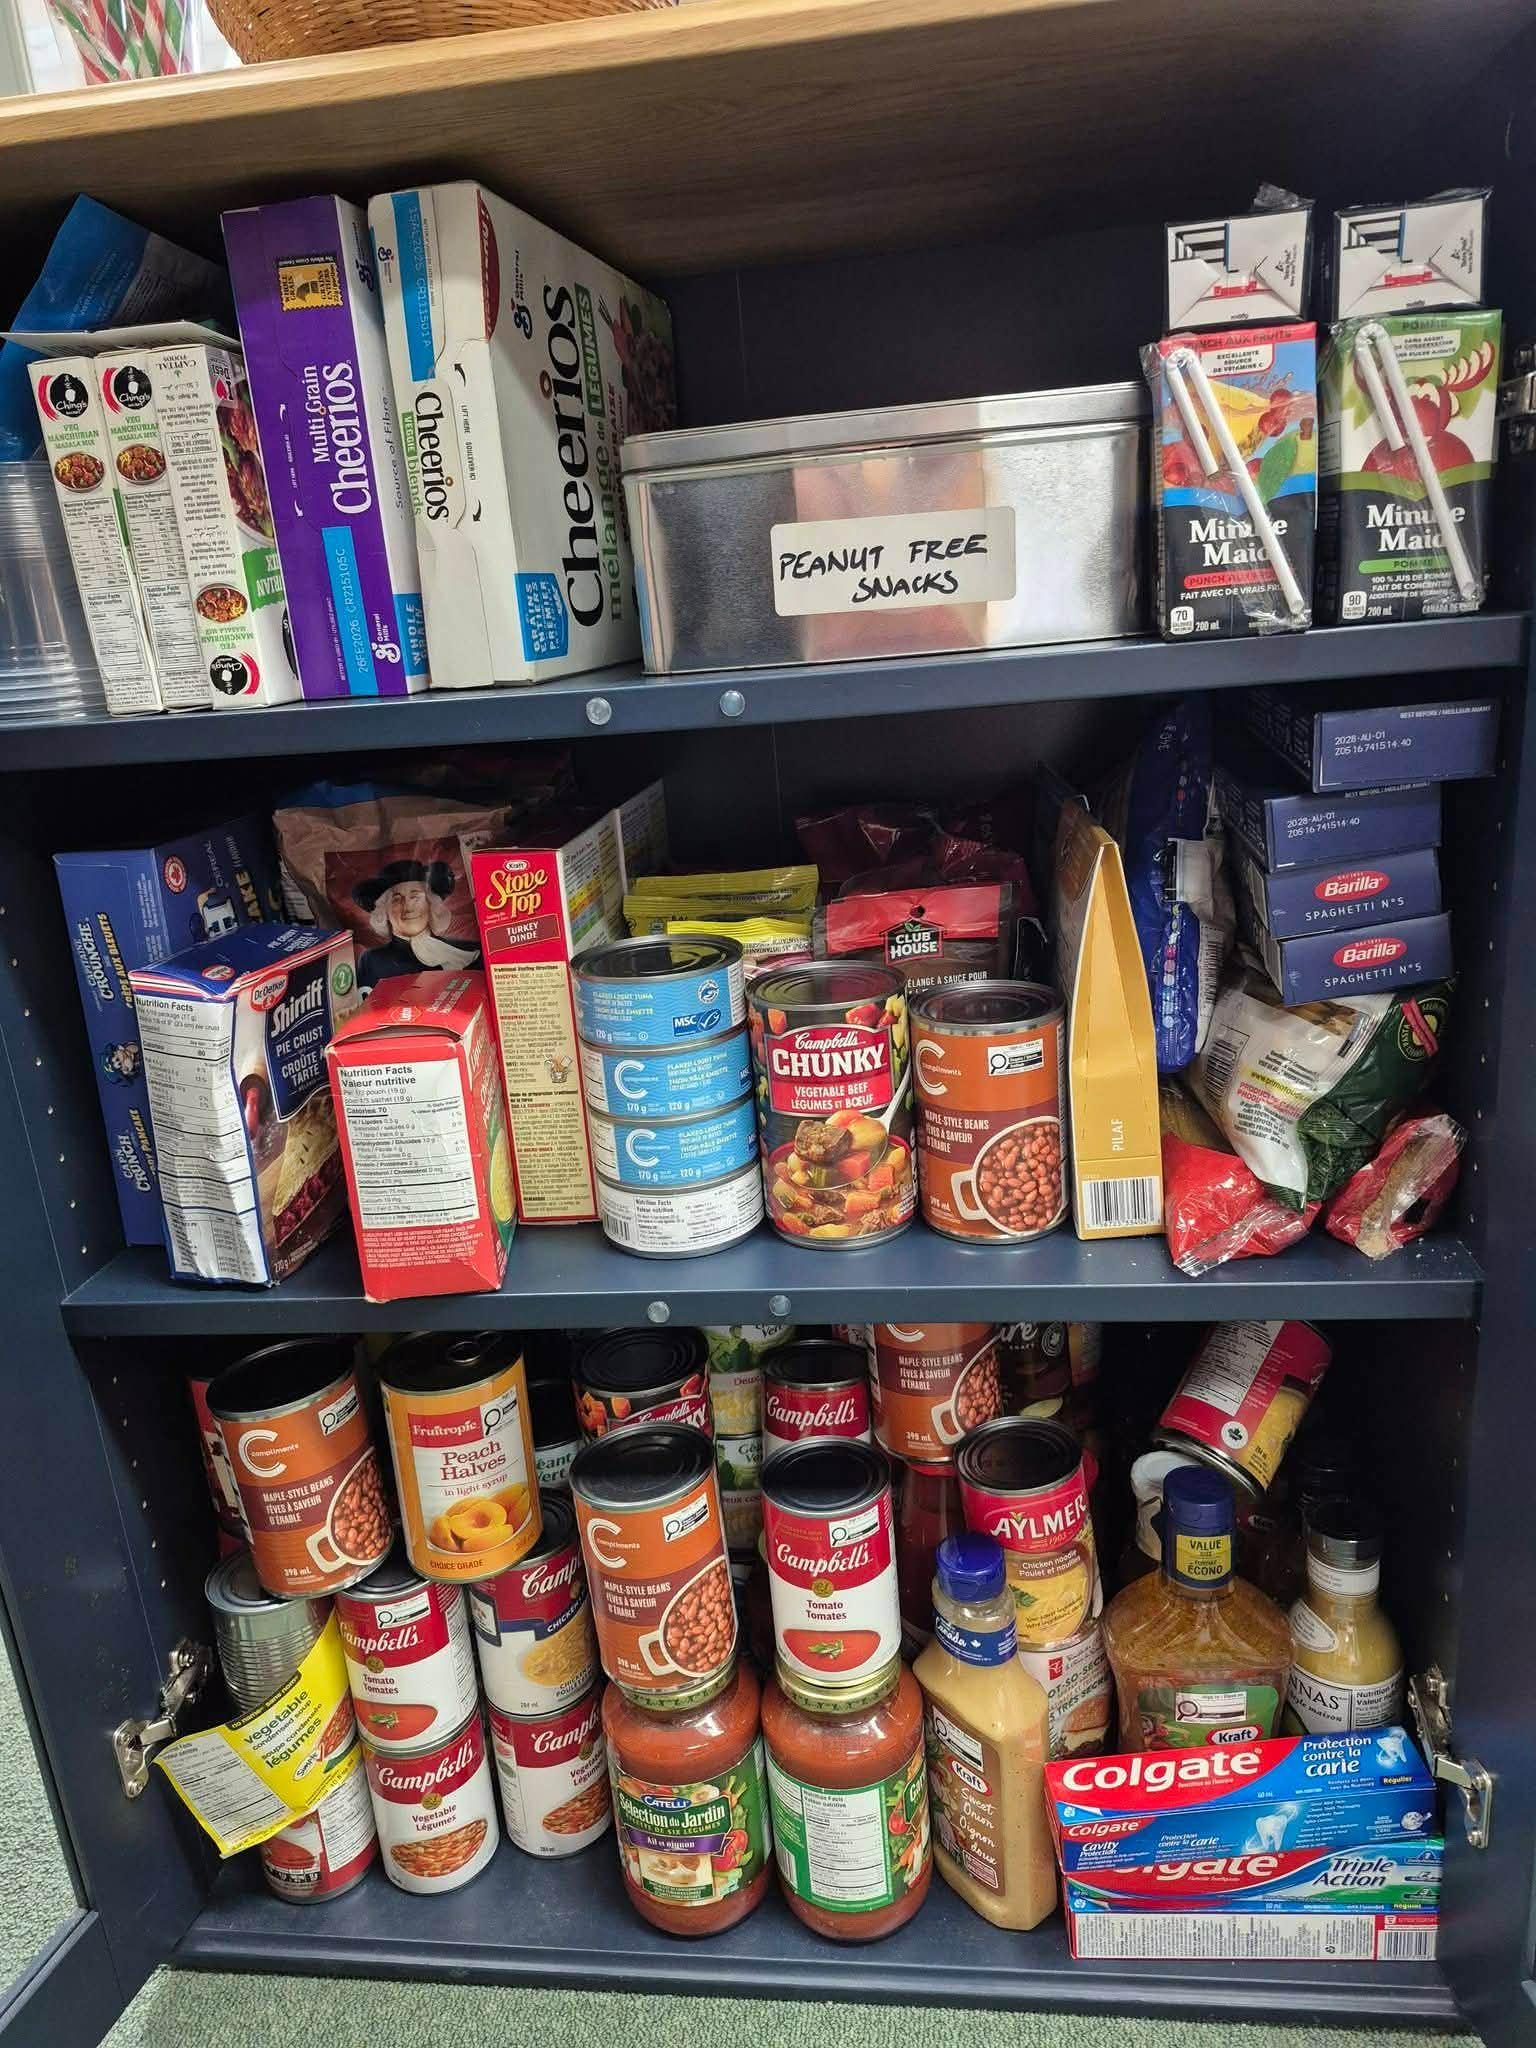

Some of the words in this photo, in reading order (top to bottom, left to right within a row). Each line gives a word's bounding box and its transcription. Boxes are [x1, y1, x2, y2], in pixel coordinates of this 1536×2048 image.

[158, 360, 197, 372] CAPITAL
[301, 365, 326, 414] Grain
[55, 400, 88, 413] Ching's
[119, 393, 151, 404] Ching's
[382, 396, 394, 434] Fibre
[309, 418, 331, 464] Multi
[322, 361, 372, 515] Cheerios
[405, 415, 415, 454] VEGGIE
[415, 391, 450, 521] Cheerios
[543, 284, 604, 628] Cheerios
[390, 460, 404, 509] Source
[407, 455, 424, 515] blends
[779, 545, 885, 581] PEANUT
[908, 533, 989, 564] FREE
[1189, 574, 1225, 586] PUNCH
[1395, 574, 1411, 582] JUS
[851, 570, 960, 604] SNACKS
[1180, 591, 1199, 601] FAIT
[1200, 589, 1224, 599] AVEC
[1225, 587, 1239, 596] DE
[1240, 585, 1265, 595] VRAIS
[1372, 583, 1390, 592] FAIT
[1348, 594, 1362, 606] 90
[1175, 610, 1188, 621] 70
[1367, 606, 1382, 617] 200
[405, 602, 423, 666] WHOLE
[1195, 621, 1210, 631] 200
[350, 619, 369, 673] 26FE2026
[1335, 730, 1386, 746] 2028-AU-01
[1287, 811, 1336, 828] 2028-AU-01
[485, 868, 549, 911] Stove
[1324, 876, 1383, 898] Barilla
[507, 893, 542, 919] Top
[1305, 902, 1375, 921] SPAGHETTI
[506, 921, 540, 937] TURKEY
[510, 931, 538, 945] DINDE
[894, 930, 932, 946] CLUB
[890, 941, 938, 961] HOUSE
[1342, 942, 1401, 964] Barilla
[78, 922, 114, 1001] CROUNCHE
[946, 972, 967, 984] SAUCE
[968, 970, 988, 982] POUR
[1324, 967, 1394, 988] SPAGHETTI
[136, 997, 170, 1010] Nutrition
[171, 1001, 194, 1012] Facts
[270, 976, 324, 1039] Shirriff
[673, 1014, 697, 1028] MSC
[276, 1041, 292, 1058] PIE
[292, 1025, 324, 1049] CRUST
[794, 1030, 866, 1053] Campbell's
[281, 1050, 319, 1080] CROÛTE
[771, 1042, 886, 1078] CHUNKY
[290, 1064, 321, 1088] TARTE
[340, 1068, 383, 1078] Nutrition
[385, 1066, 413, 1075] Facts
[342, 1079, 375, 1089] Valeur
[375, 1076, 417, 1087] nutritive
[794, 1085, 845, 1099] VEGETABLE
[847, 1082, 869, 1097] BEEF
[378, 1106, 388, 1114] 70
[627, 1103, 640, 1112] 170
[640, 1105, 647, 1114] g
[684, 1102, 690, 1112] g
[791, 1097, 834, 1111] LÉGUMES
[925, 1110, 963, 1130] MAPLE-STYLE
[964, 1117, 990, 1131] BEANS
[946, 1129, 973, 1144] SAVEUR
[1111, 1117, 1125, 1152] PILAF
[118, 1135, 151, 1192] CRUNCH
[638, 1170, 651, 1180] 170
[652, 1171, 658, 1180] g
[680, 1167, 695, 1178] 120
[695, 1167, 701, 1178] g
[925, 1367, 951, 1379] SAVEUR
[767, 1396, 857, 1429] Campbell's
[411, 1420, 479, 1437] Fruitropic
[905, 1431, 920, 1441] 398
[441, 1440, 502, 1467] Peach
[439, 1453, 507, 1482] Halves
[262, 1484, 311, 1504] MAPLE-STYLE
[310, 1475, 335, 1491] BEANS
[443, 1487, 455, 1497] in
[456, 1483, 480, 1497] light
[481, 1471, 509, 1491] syrup
[293, 1495, 323, 1511] SAVEUR
[990, 1492, 1088, 1540] AYLMER
[1189, 1538, 1223, 1551] VALUE
[429, 1559, 455, 1570] CHOICE
[456, 1559, 484, 1570] GRADE
[775, 1537, 874, 1578] Campbell's
[1022, 1558, 1054, 1571] Chicken
[1054, 1549, 1078, 1566] noodle
[283, 1567, 298, 1577] 398
[1019, 1565, 1046, 1577] Poulet
[1046, 1566, 1055, 1575] et
[603, 1580, 646, 1596] MAPLE-STYLE
[646, 1581, 672, 1596] BEANS
[631, 1597, 657, 1610] SAVEUR
[806, 1599, 844, 1611] Tomato
[806, 1609, 848, 1622] Tomates
[339, 1620, 424, 1654] Campbell's
[936, 1616, 967, 1649] Canada
[281, 1677, 298, 1694] nom
[362, 1672, 395, 1686] Tomato
[362, 1682, 399, 1696] Tomates
[1356, 1687, 1390, 1699] Nutrition
[1056, 1691, 1080, 1716] TRÈS
[1356, 1696, 1382, 1706] Valeur
[243, 1690, 309, 1745] vegetable
[252, 1717, 295, 1752] condensed
[294, 1699, 312, 1719] soup
[265, 1717, 322, 1769] légumes
[1218, 1729, 1253, 1744] Kraft
[1303, 1736, 1372, 1752] Protection
[261, 1741, 286, 1760] soupe
[1302, 1750, 1345, 1763] contre
[1349, 1747, 1361, 1759] la
[376, 1737, 475, 1793] Campbell's
[1062, 1749, 1261, 1793] Colgate
[1305, 1759, 1360, 1777] carie
[954, 1762, 984, 1793] Kraft
[1383, 1775, 1413, 1785] Régulier
[644, 1795, 688, 1809] CATELLI
[960, 1786, 995, 1817] Sweet
[411, 1803, 458, 1823] Vegetable
[619, 1792, 669, 1829] Sélection
[669, 1818, 681, 1827] du
[681, 1804, 726, 1829] Jardin
[962, 1800, 995, 1829] Onion
[415, 1813, 457, 1832] Légumes
[959, 1814, 997, 1848] Oignon
[1068, 1821, 1141, 1838] Colgate
[647, 1836, 658, 1846] Ail
[666, 1840, 696, 1849] oignon
[1157, 1839, 1181, 1848] contre
[1190, 1835, 1220, 1848] carie
[1160, 1832, 1198, 1842] Protection
[970, 1836, 997, 1866] doux
[1079, 1850, 1118, 1858] Protection
[1082, 1840, 1120, 1853] Cavity
[1332, 1857, 1394, 1874] Triple
[1312, 1872, 1387, 1888] Action
